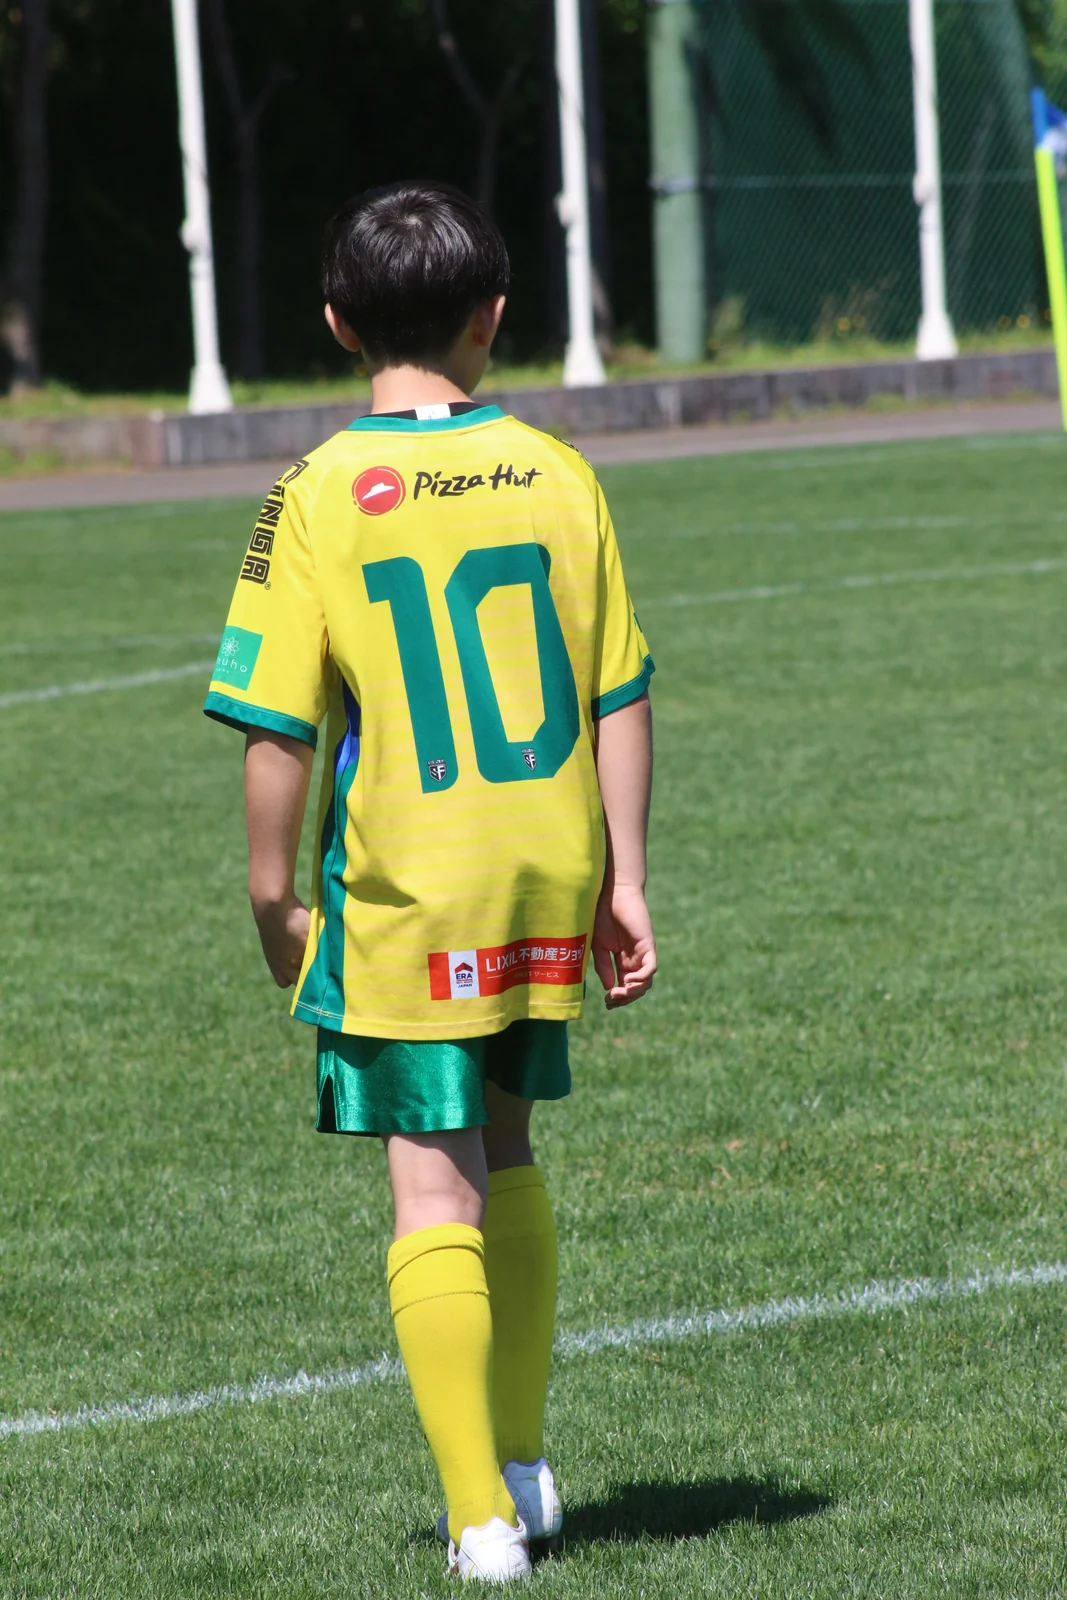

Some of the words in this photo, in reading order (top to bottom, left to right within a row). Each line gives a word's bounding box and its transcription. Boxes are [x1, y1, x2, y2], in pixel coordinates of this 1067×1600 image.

[413, 471, 486, 501] Pizza
[488, 463, 543, 491] Hut
[362, 542, 580, 794] 10
